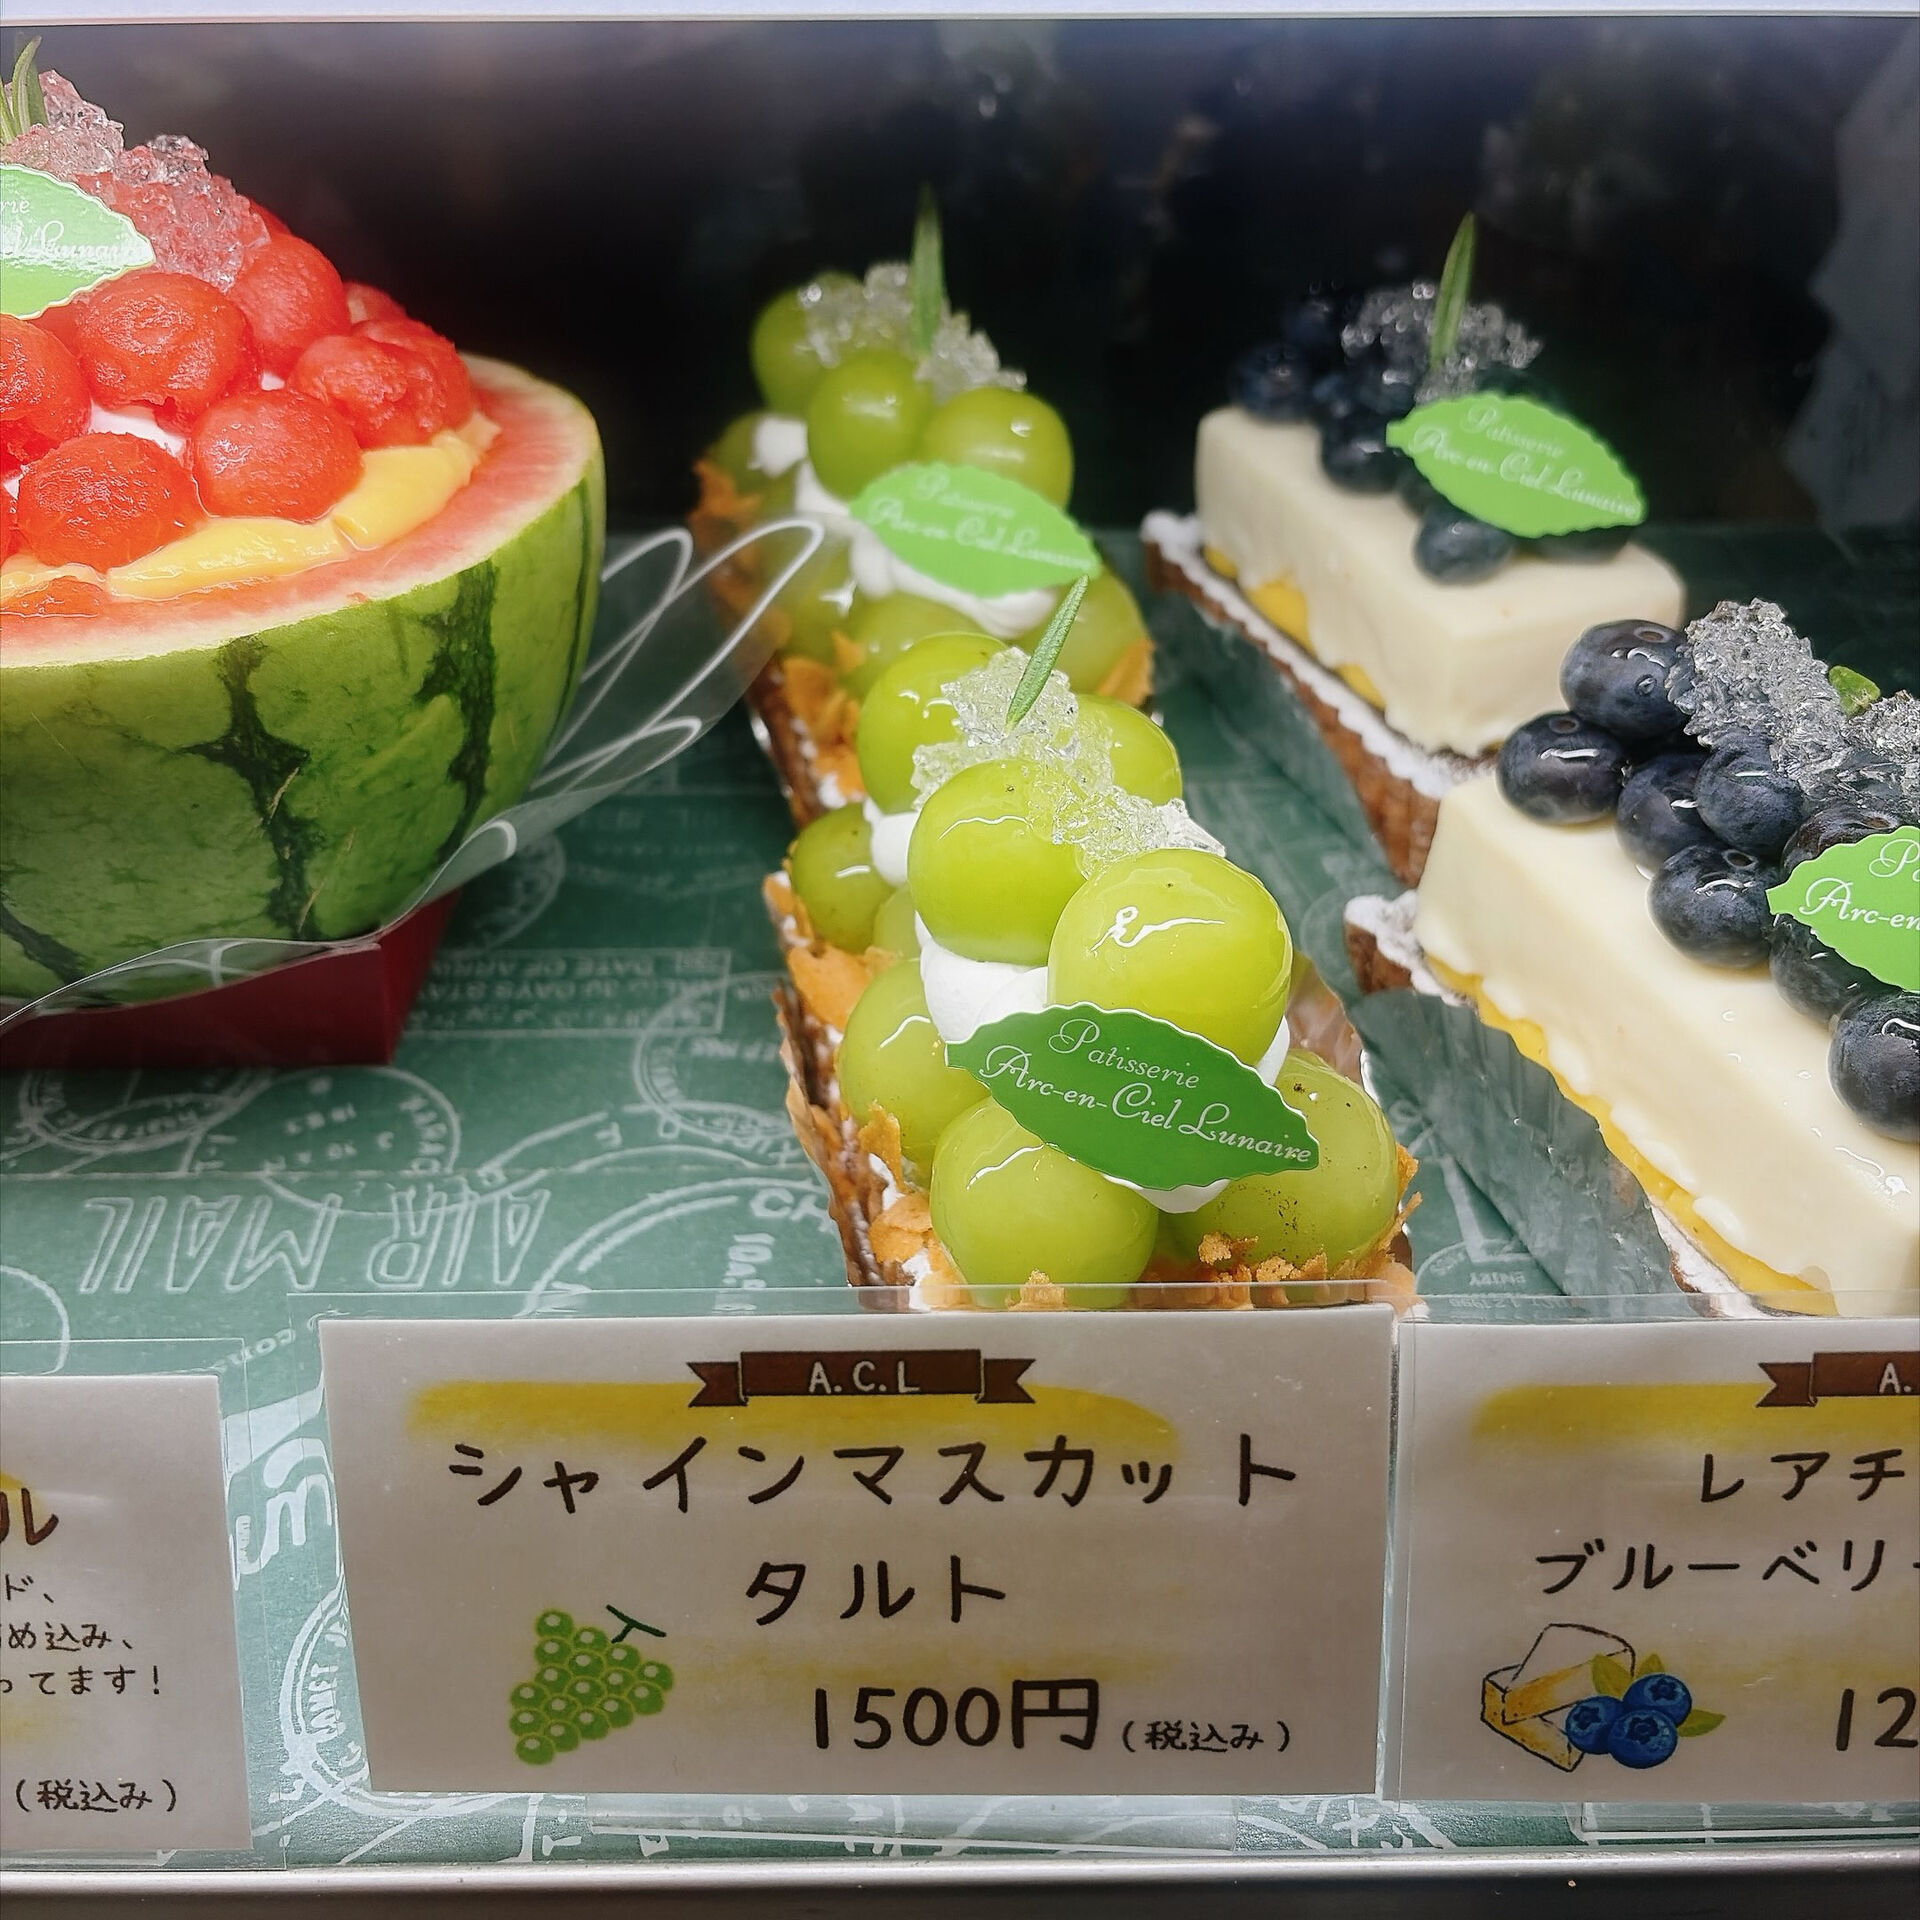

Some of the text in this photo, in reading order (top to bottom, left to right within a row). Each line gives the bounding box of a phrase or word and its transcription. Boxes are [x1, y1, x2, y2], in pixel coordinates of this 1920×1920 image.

[1048, 1018, 1200, 1089] Patisserie
[978, 1044, 1312, 1163] Arc-en-Ciel Lunaire
[80, 1186, 551, 1294] AIR MAIL
[808, 1360, 921, 1394] A.C.L
[448, 1434, 1297, 1507] シャインマスカット
[1701, 1448, 1906, 1504] レアチ
[745, 1554, 1006, 1626] タルト
[1536, 1537, 1920, 1595] ブルーベリ
[0, 1621, 134, 1652] め込み、
[813, 1677, 1292, 1753] 1500円 (税込み)
[1835, 1686, 1919, 1752] 12
[15, 1778, 177, 1813] (税込み)
